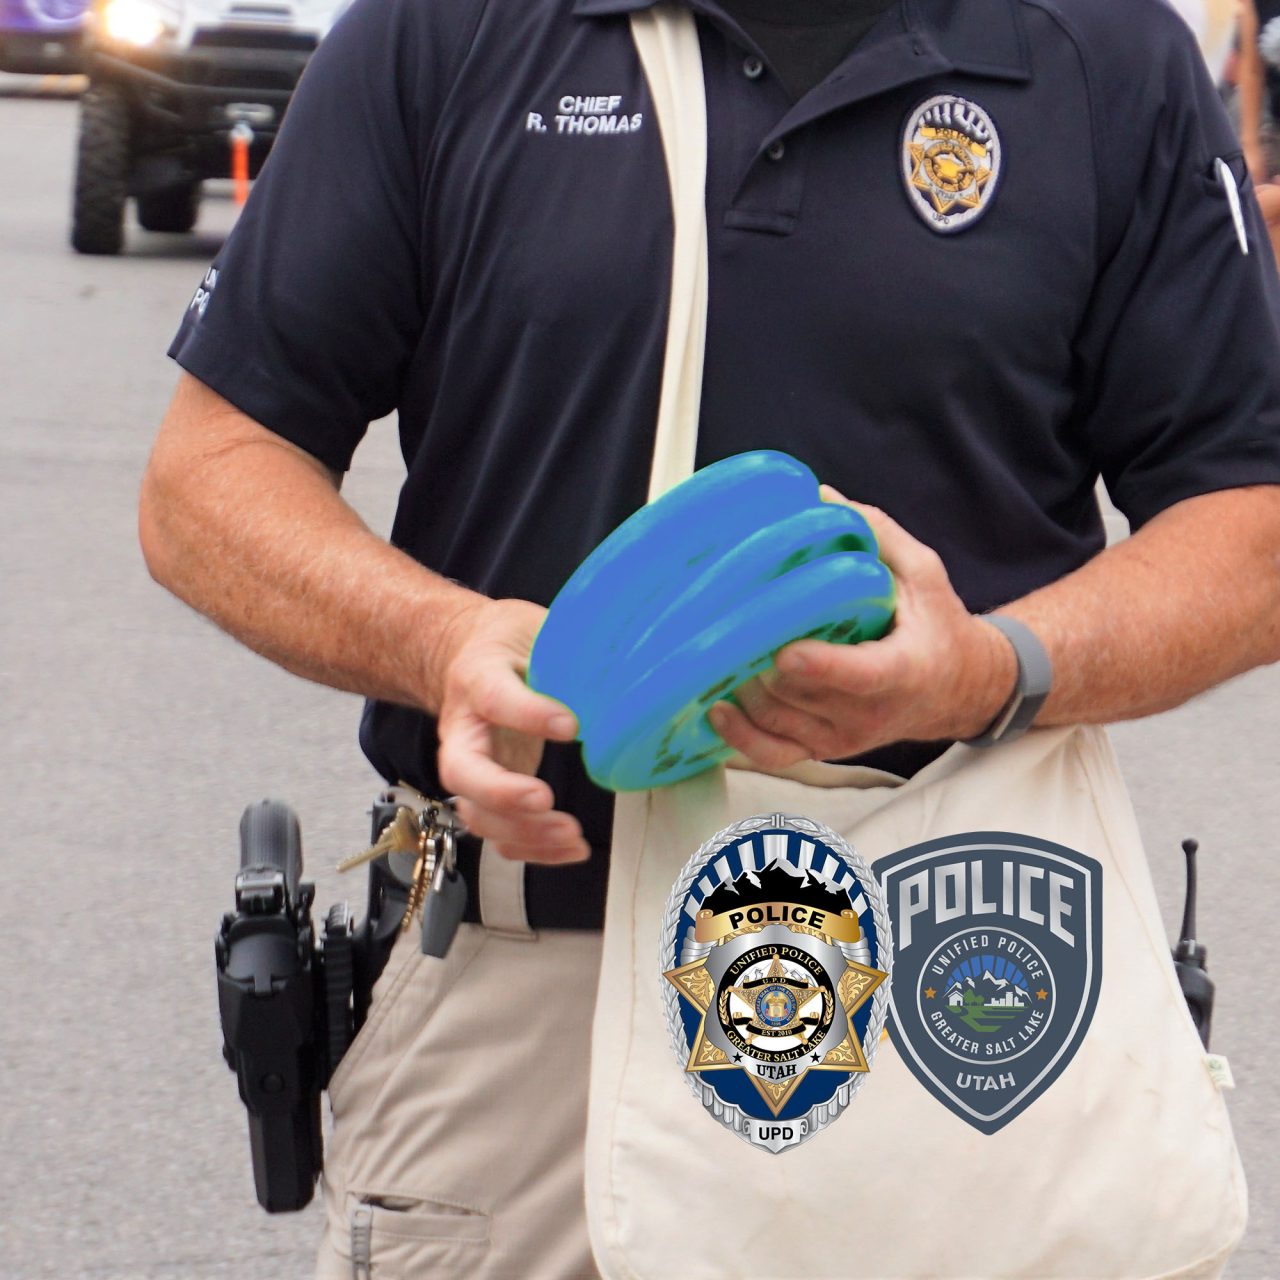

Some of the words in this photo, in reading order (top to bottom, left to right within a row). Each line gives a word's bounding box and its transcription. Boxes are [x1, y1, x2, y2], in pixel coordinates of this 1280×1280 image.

[559, 95, 622, 114] CHIEF
[526, 112, 547, 132] R.
[555, 113, 643, 135] THOMAS
